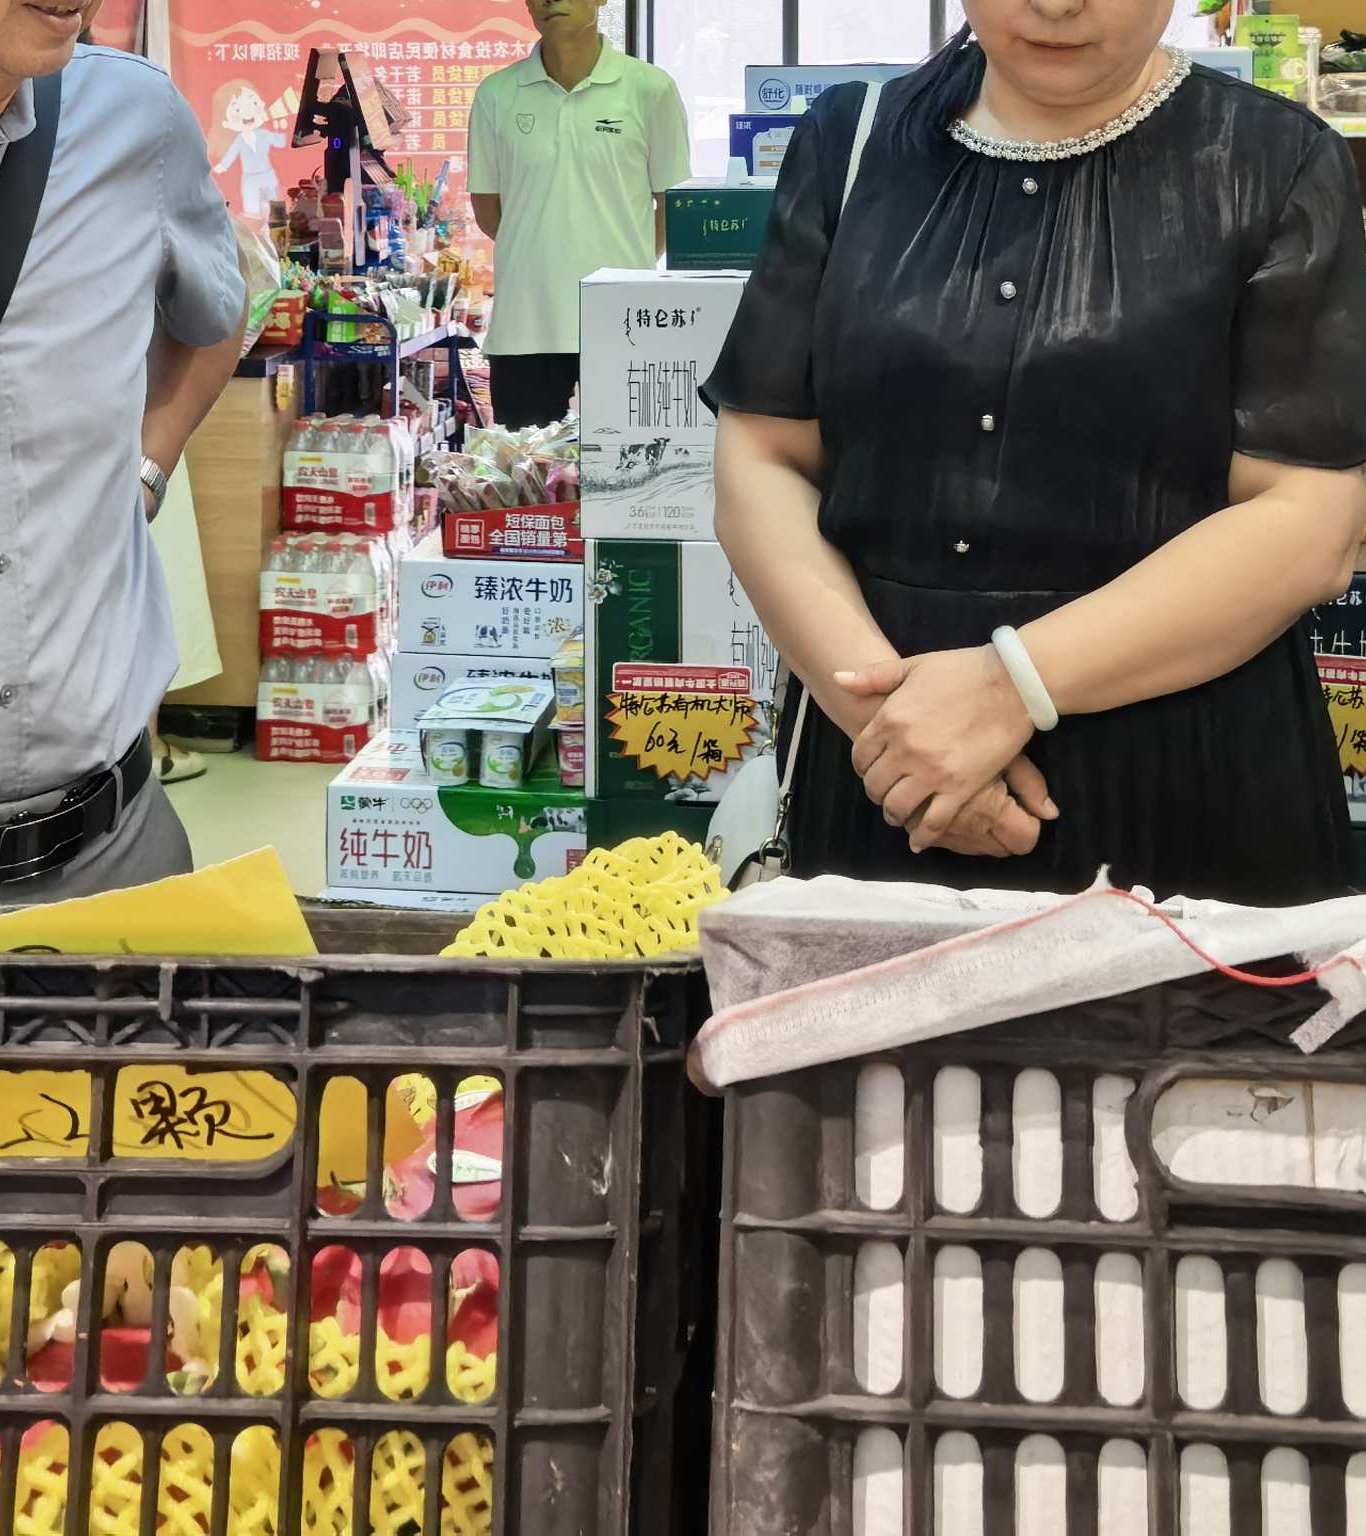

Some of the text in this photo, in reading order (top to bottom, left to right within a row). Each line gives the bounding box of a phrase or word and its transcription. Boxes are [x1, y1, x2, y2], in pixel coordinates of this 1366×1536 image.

[636, 308, 687, 329] 特仑苏
[506, 514, 566, 529] 短保面包
[474, 576, 573, 604] 臻浓牛奶
[358, 795, 388, 810] 蒙牛
[339, 827, 433, 870] 纯牛奶
